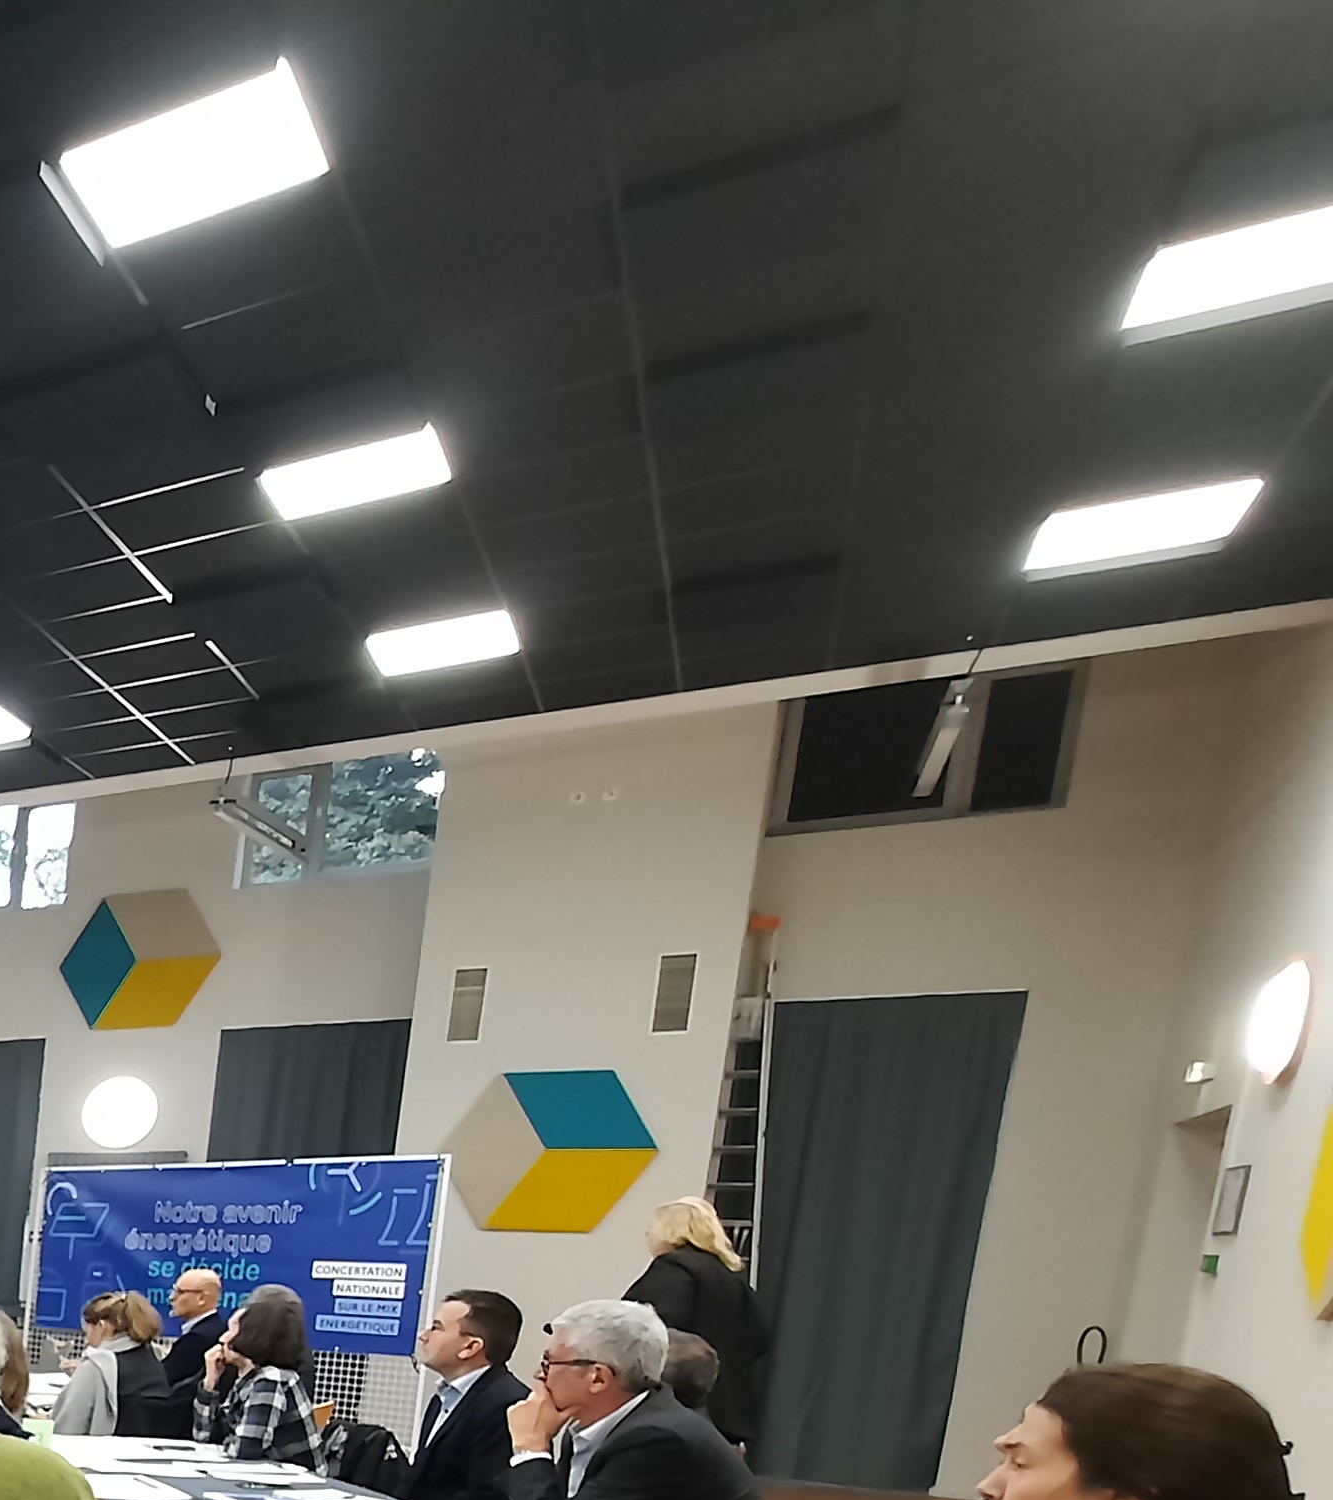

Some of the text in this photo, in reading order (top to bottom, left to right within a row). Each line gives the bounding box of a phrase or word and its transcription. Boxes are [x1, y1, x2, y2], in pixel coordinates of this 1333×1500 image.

[154, 1200, 303, 1224] Notre avenir
[124, 1228, 272, 1257] énergétique
[147, 1259, 175, 1278] se
[315, 1264, 403, 1277] CONCERTATION
[336, 1284, 401, 1295] NATIONALE
